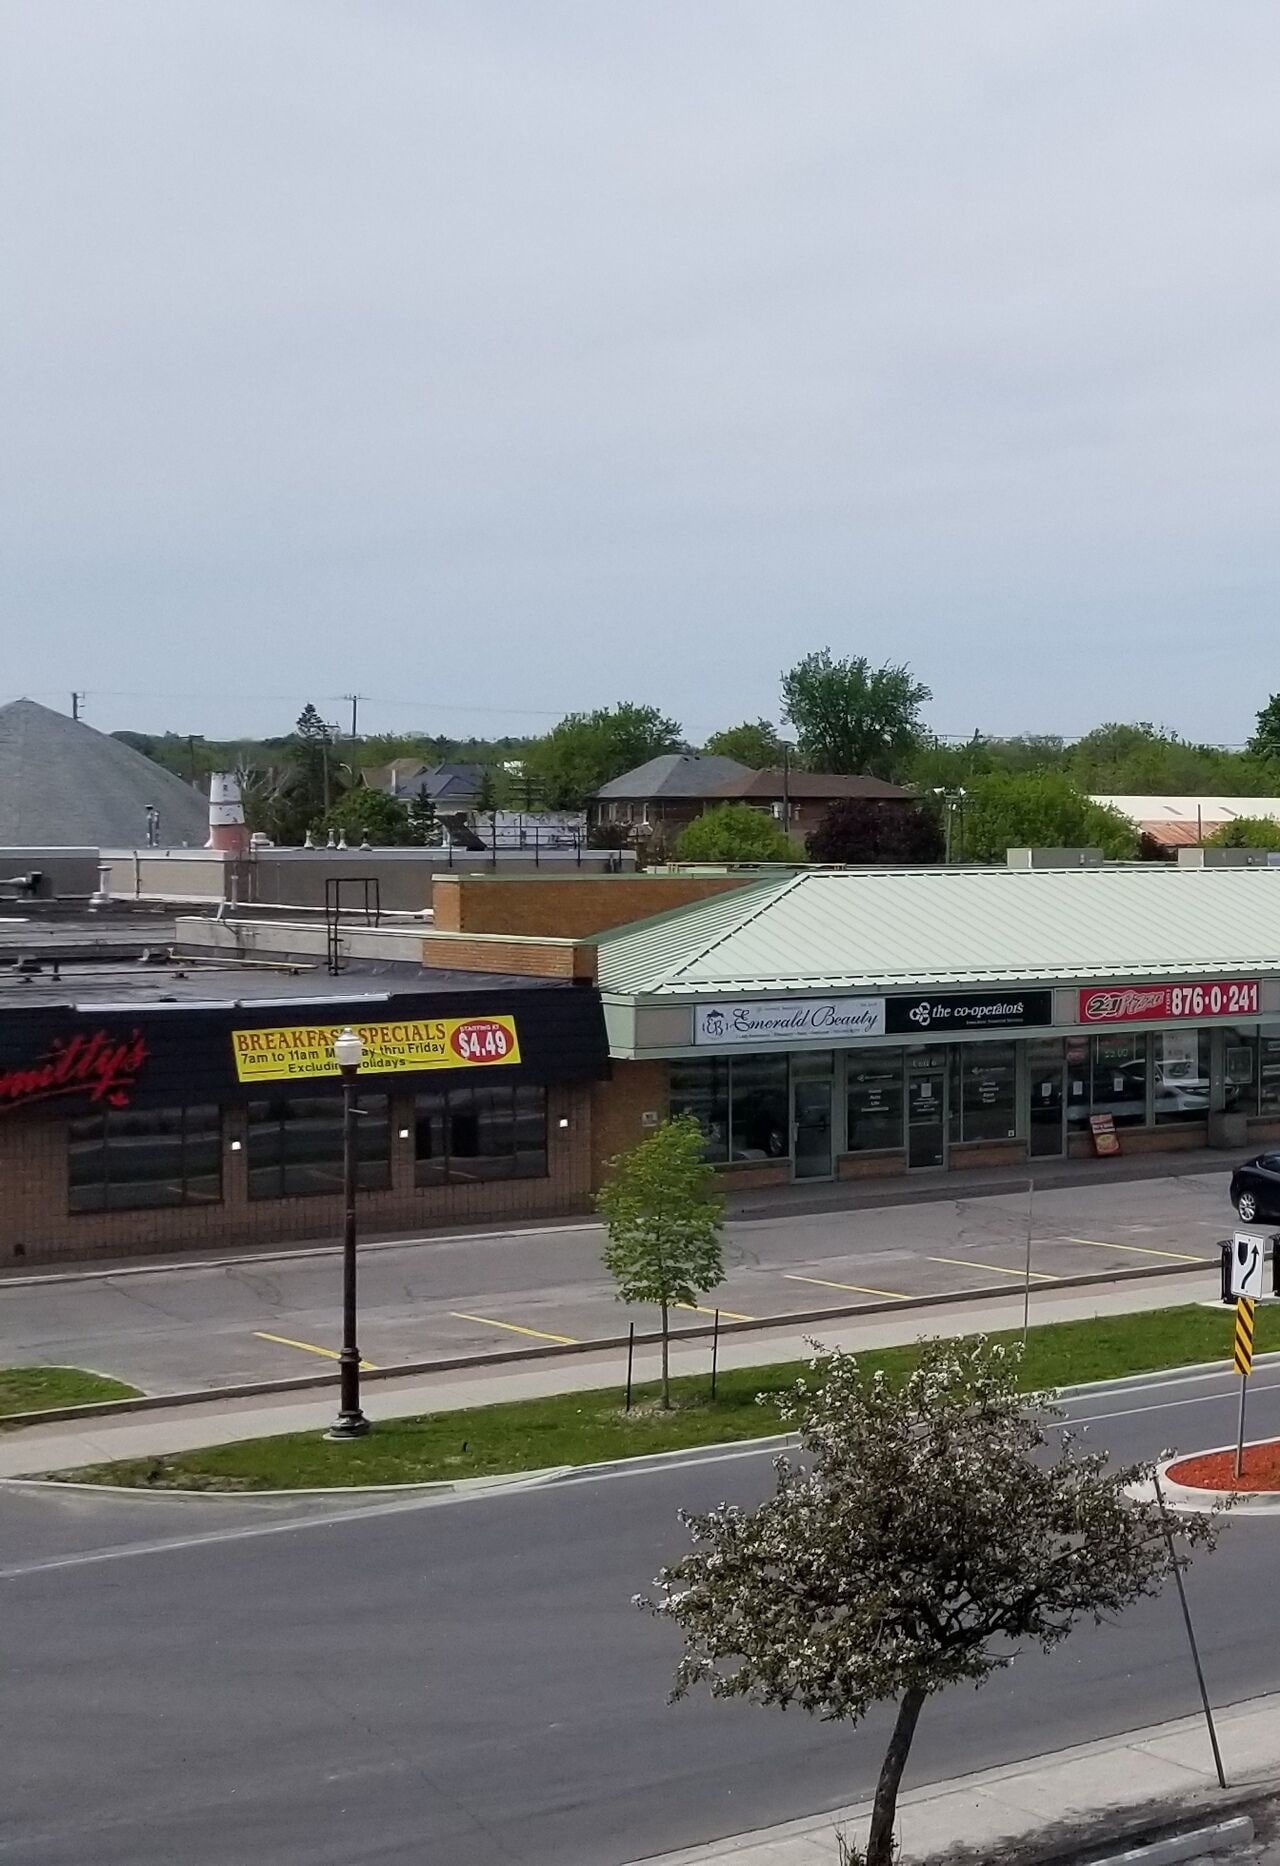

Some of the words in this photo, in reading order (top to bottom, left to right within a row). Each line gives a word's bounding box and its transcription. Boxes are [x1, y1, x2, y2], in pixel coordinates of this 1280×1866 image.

[731, 1008, 811, 1032] Emerald
[810, 1005, 878, 1033] Beauty
[931, 1005, 951, 1018] the
[953, 1002, 1024, 1019] co-operators
[236, 1029, 343, 1052] BREAKFAS
[358, 1023, 447, 1045] SPECIALS
[458, 1030, 507, 1060] $4.49
[241, 1052, 270, 1065] 7am
[272, 1051, 286, 1063] to
[288, 1049, 320, 1062] 11am
[379, 1043, 406, 1056] thru
[407, 1041, 446, 1055] Friday
[357, 1058, 407, 1070] olidays
